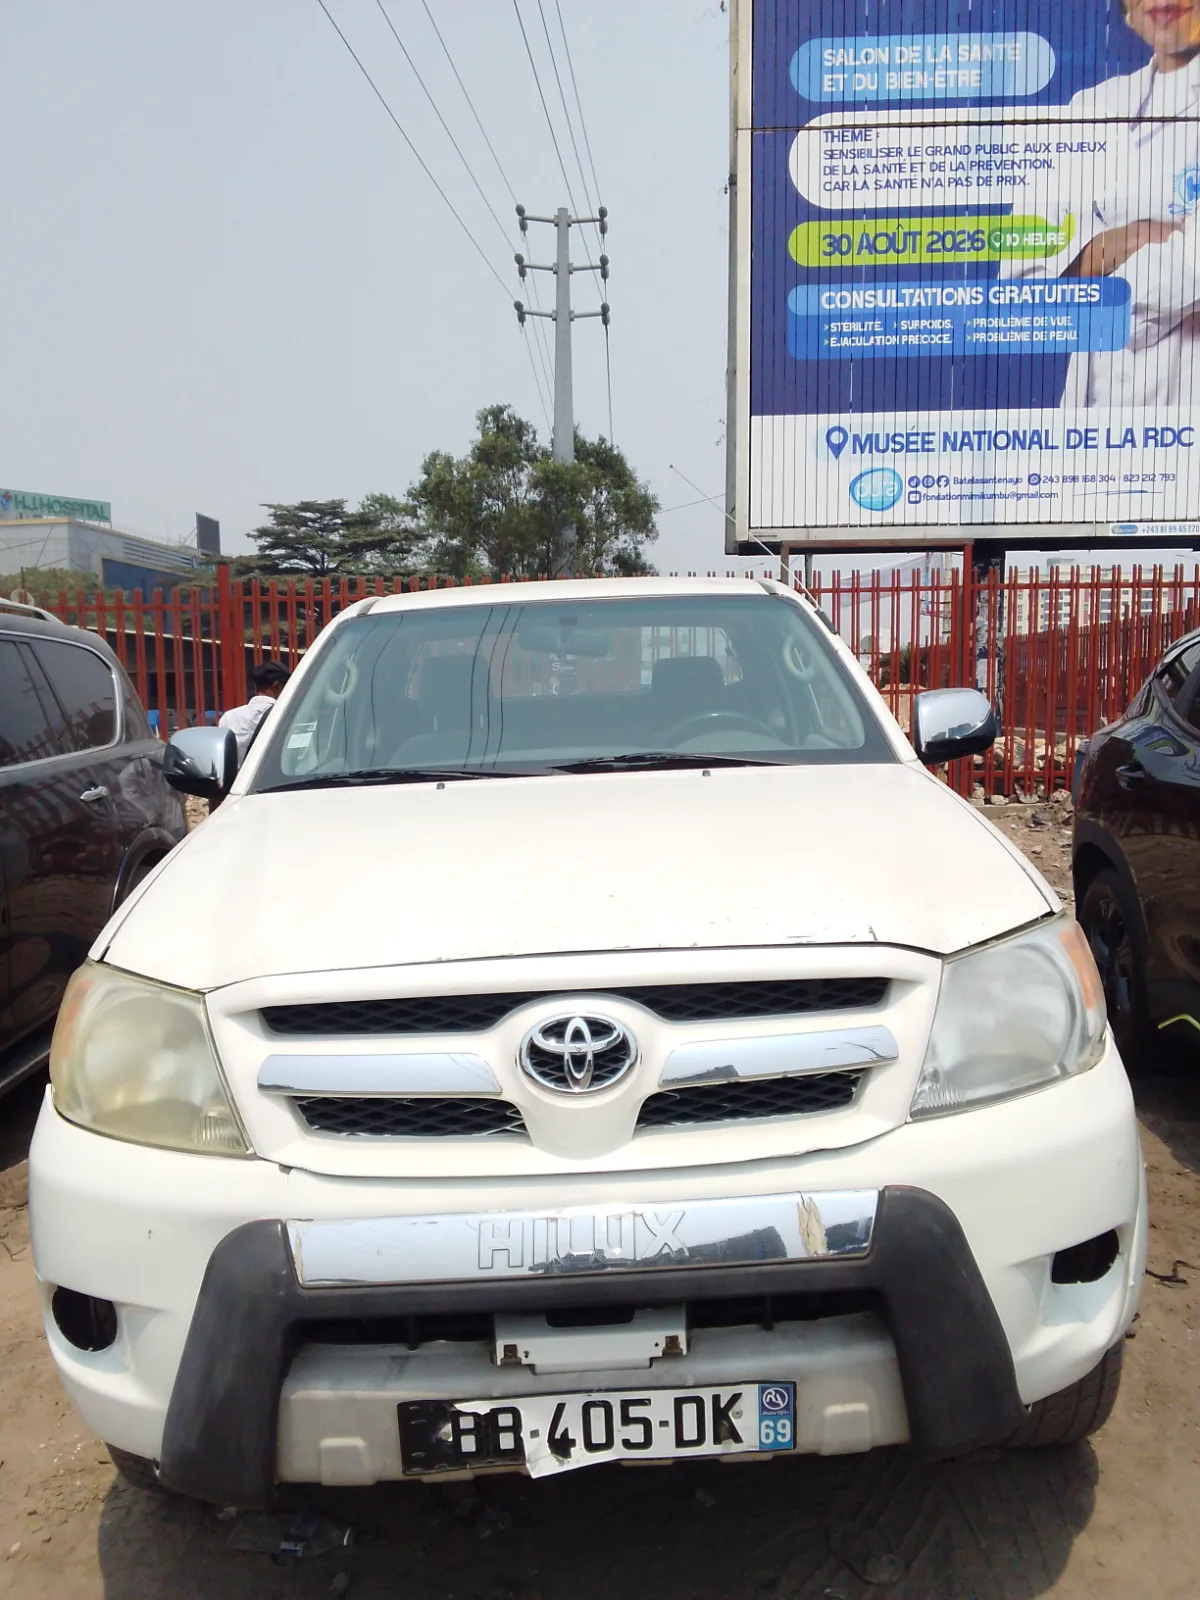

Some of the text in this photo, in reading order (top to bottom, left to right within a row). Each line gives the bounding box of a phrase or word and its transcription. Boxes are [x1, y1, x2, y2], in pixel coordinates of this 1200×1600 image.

[824, 39, 1021, 66] SALON DE LA SANTÉ
[823, 65, 983, 92] ET DU BIEN-ÊTRE
[823, 141, 1106, 160] SENSIBILISER LE GRAND PUBLIC AUX ENJEUX
[823, 165, 839, 176] DE
[843, 164, 859, 175] LA
[863, 159, 907, 175] SANTÉ
[910, 162, 926, 173] ET
[929, 161, 946, 172] DE
[949, 160, 965, 172] LA
[823, 181, 850, 192] CAR
[853, 180, 869, 191] LA
[921, 177, 944, 188] N'A
[947, 176, 972, 188] PAS
[976, 175, 993, 187] DE
[996, 174, 1030, 186] PRIX.
[822, 233, 851, 257] 30
[856, 223, 922, 255] AOÛT
[926, 229, 986, 253] 2026
[1006, 234, 1020, 247] 10
[821, 283, 1100, 309] CONSULTATIONS GRATUITES
[1033, 317, 1048, 327] DE
[1033, 331, 1047, 341] DE
[852, 425, 1195, 455] MUSÉE NATIONAL DE LA RDC
[1042, 475, 1060, 483] 243
[1099, 474, 1116, 483] 304
[1142, 473, 1156, 482] 212
[478, 1210, 690, 1270] HILUX
[760, 1419, 791, 1444] 69
